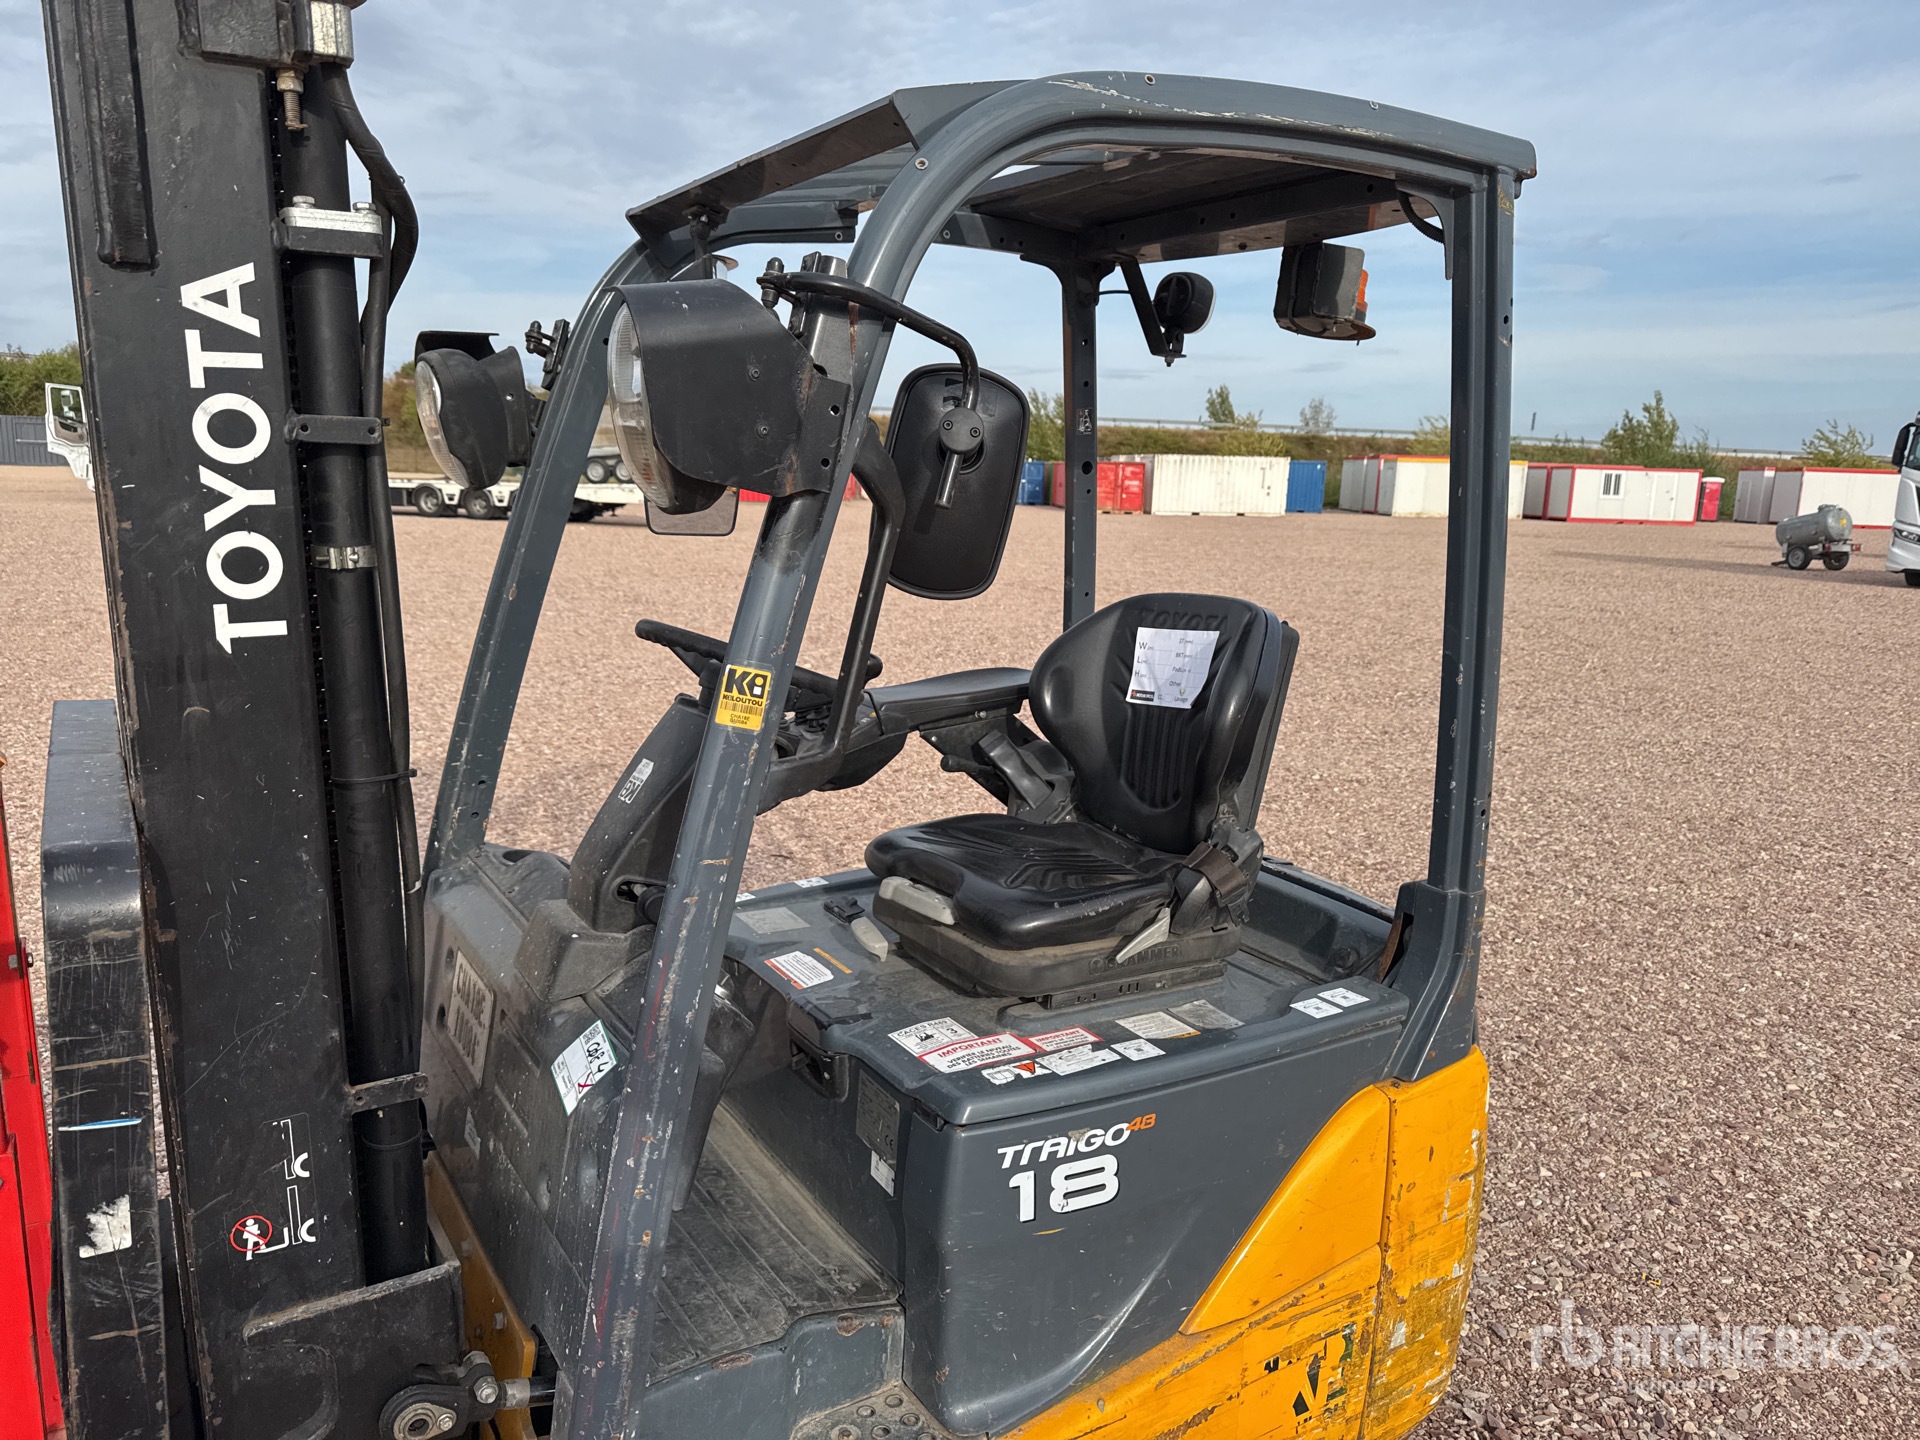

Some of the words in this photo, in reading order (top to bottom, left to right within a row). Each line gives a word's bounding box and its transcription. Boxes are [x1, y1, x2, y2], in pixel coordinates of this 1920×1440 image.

[180, 262, 288, 655] TOYOTA
[1105, 944, 1180, 969] GAMMER
[937, 1037, 1003, 1058] IMPORTANT
[986, 1044, 1012, 1053] NIVEAU
[1035, 1030, 1081, 1043] IMPORTANT
[997, 1122, 1132, 1169] TRAIGO
[1009, 1154, 1121, 1223] 18
